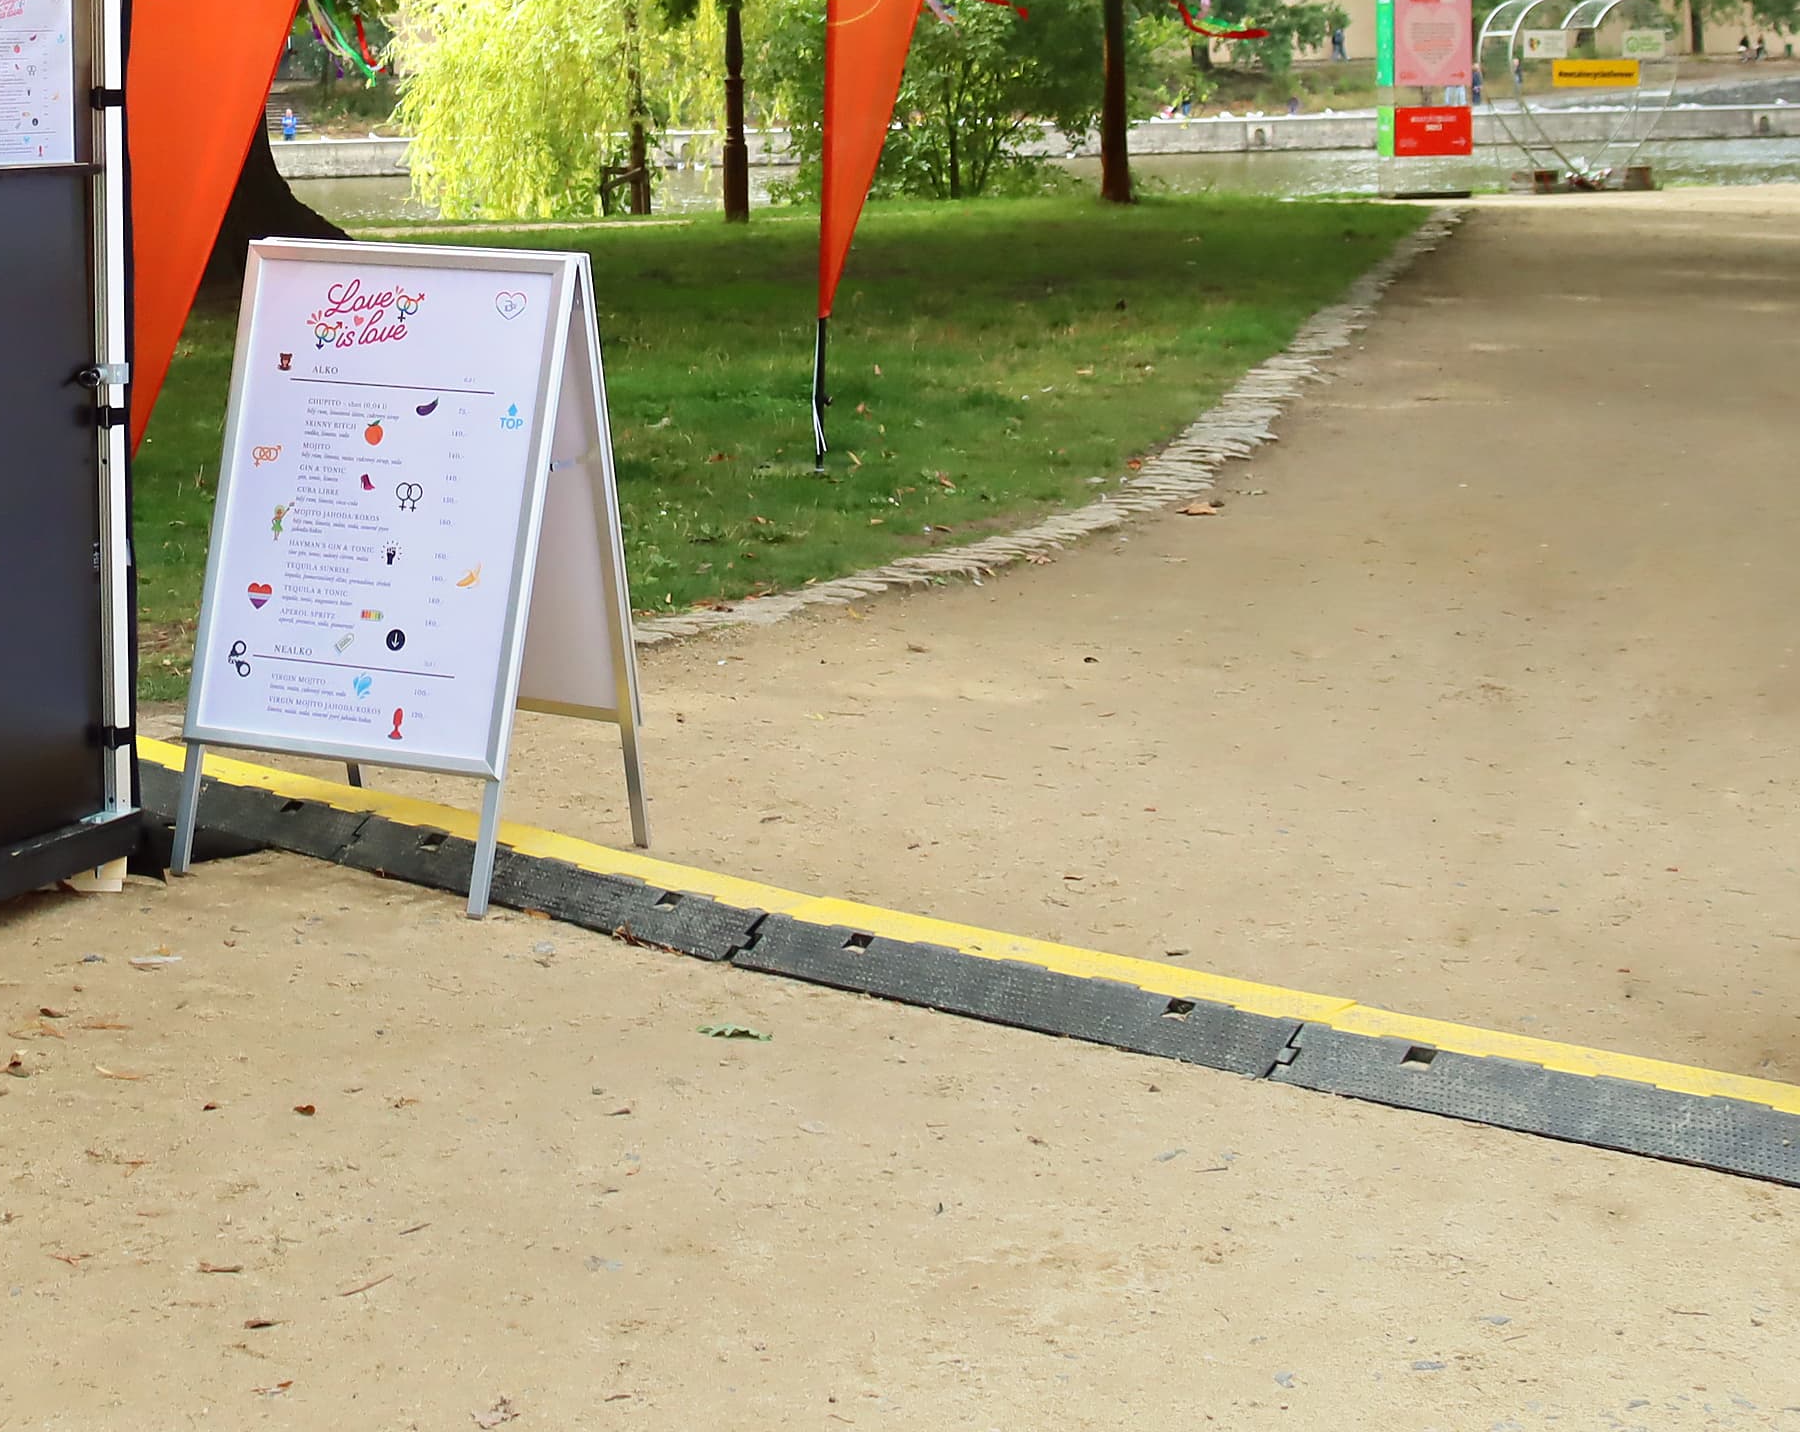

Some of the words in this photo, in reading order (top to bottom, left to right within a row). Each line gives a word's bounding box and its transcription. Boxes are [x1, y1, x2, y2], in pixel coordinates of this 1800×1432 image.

[324, 279, 395, 317] Love
[335, 326, 355, 348] is
[357, 310, 409, 347] love
[312, 365, 339, 375] ALKO
[500, 417, 524, 429] TOP
[302, 441, 331, 451] MOJITO
[300, 463, 313, 472] GIN
[286, 561, 318, 571] TEQUILA
[273, 644, 313, 656] NEALKO
